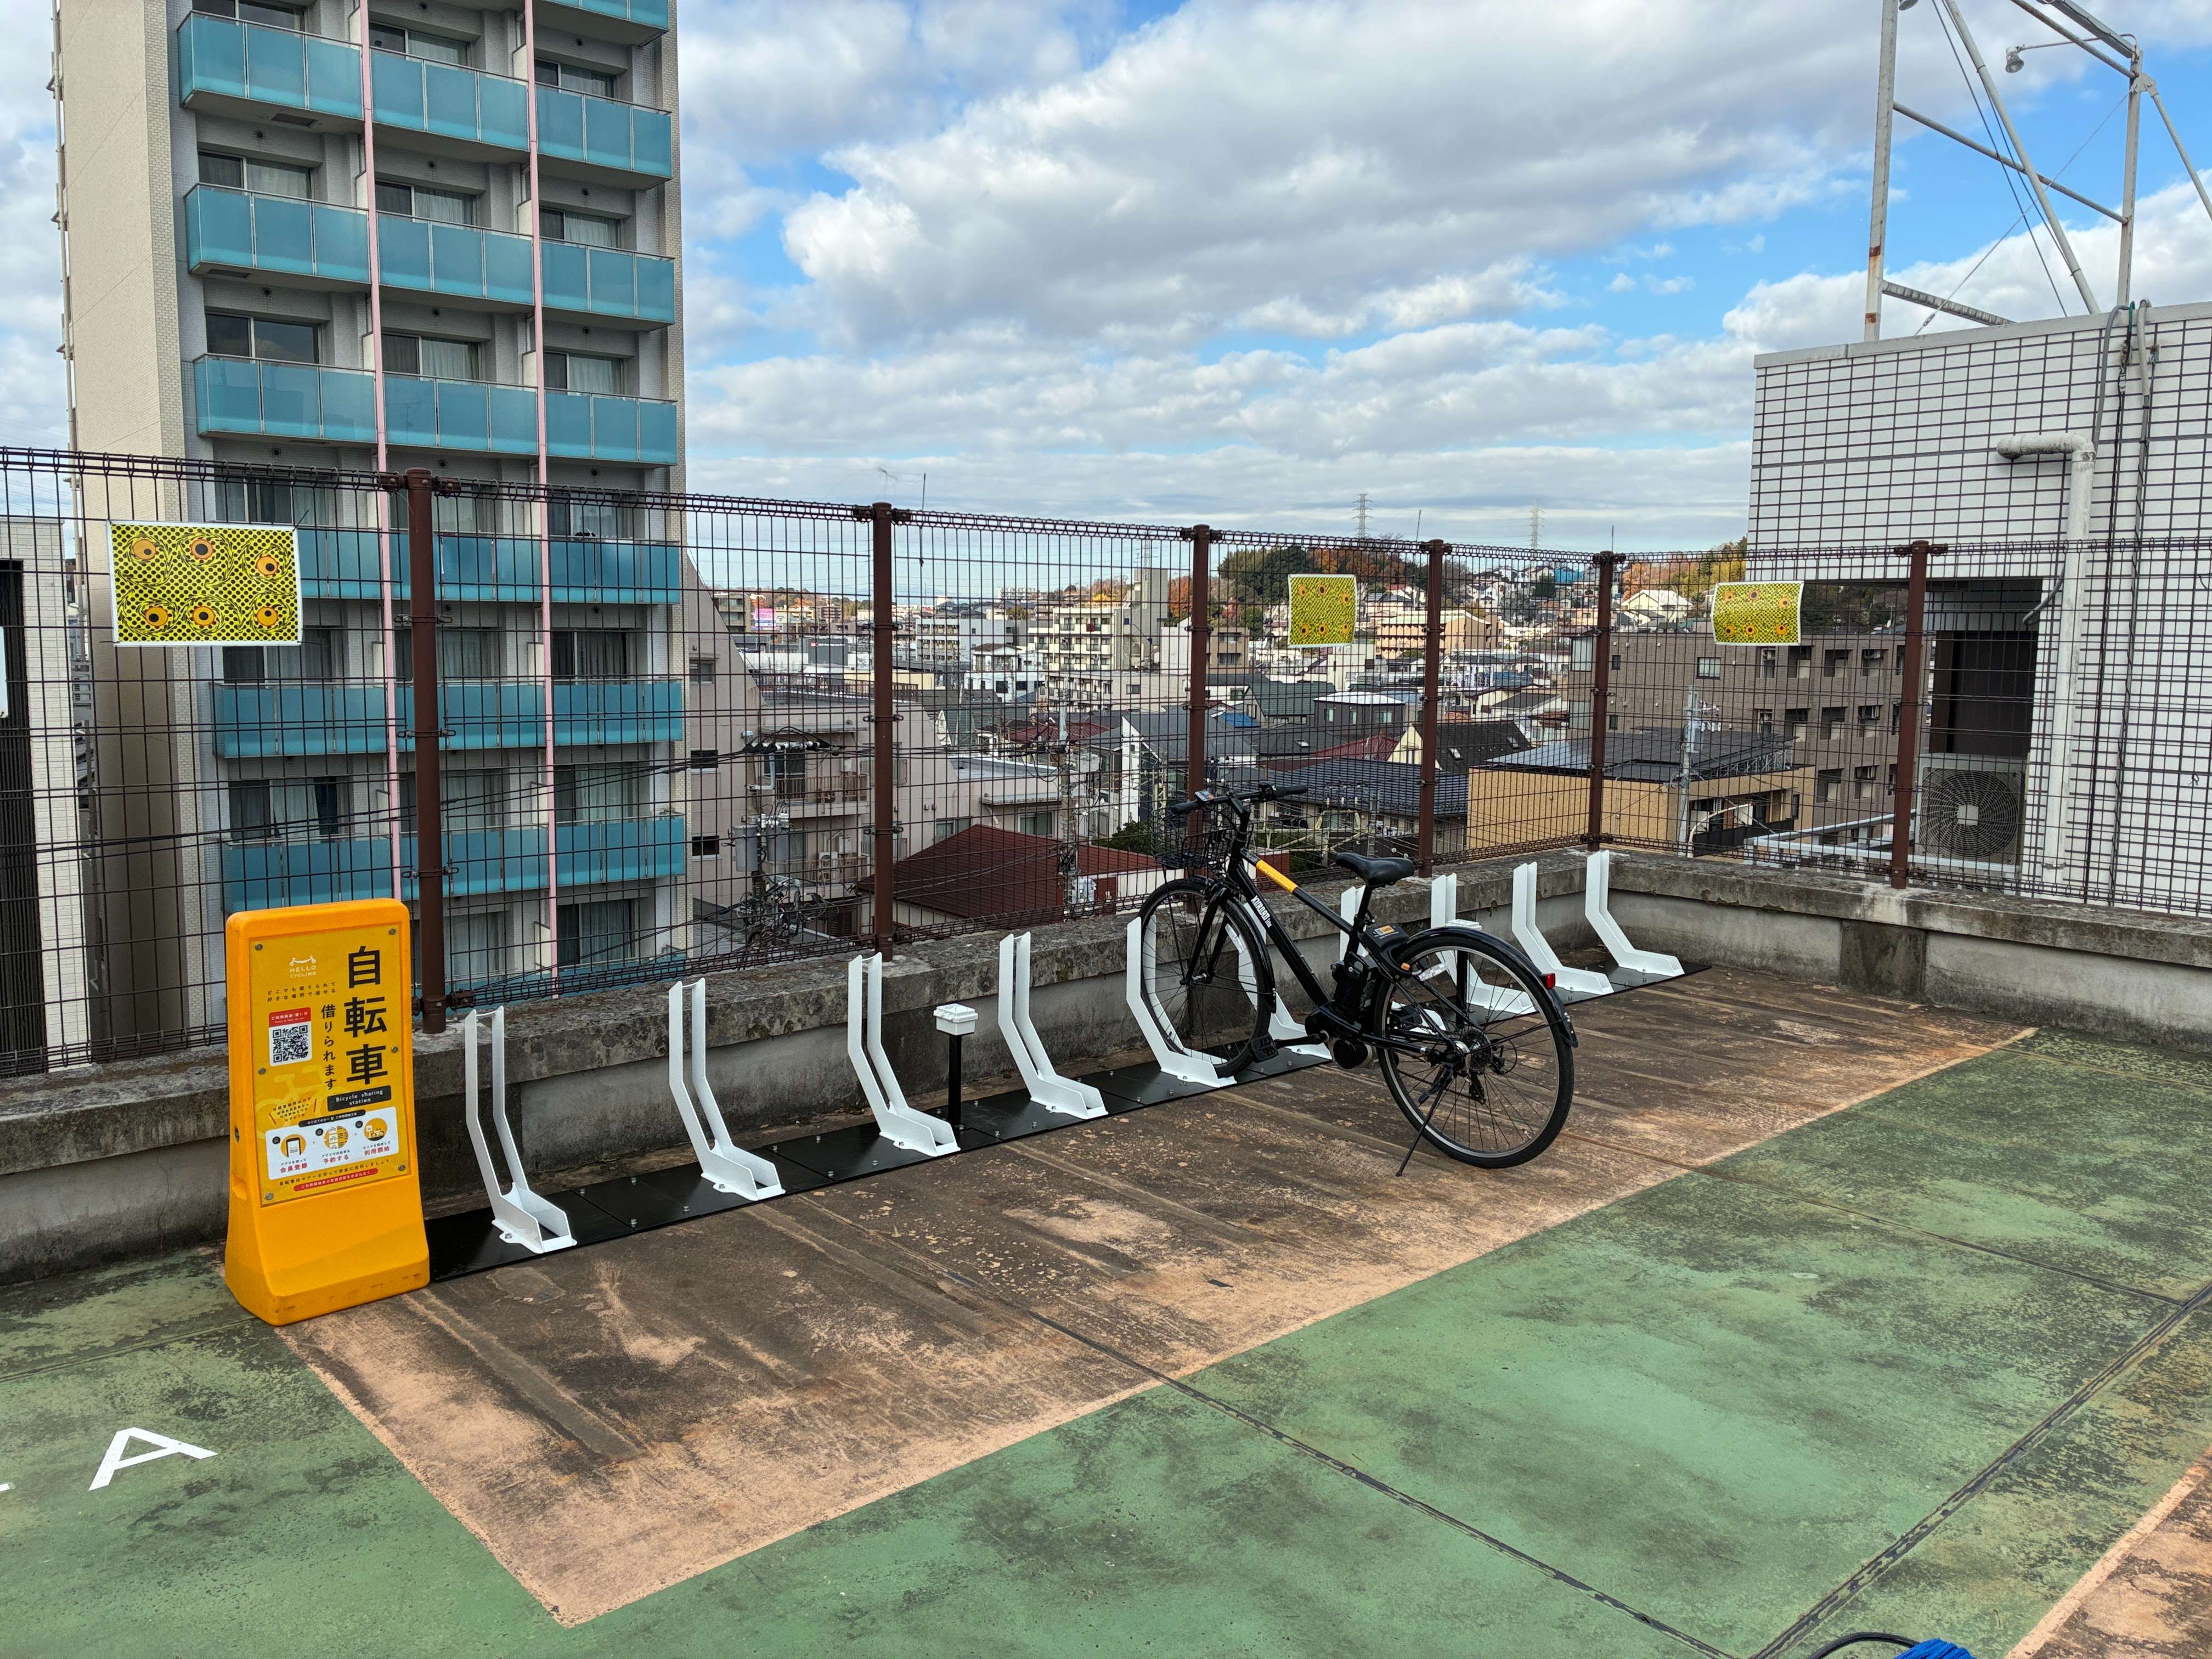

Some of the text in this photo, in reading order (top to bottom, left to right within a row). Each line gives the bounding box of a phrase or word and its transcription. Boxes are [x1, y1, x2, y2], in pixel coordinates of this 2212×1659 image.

[290, 965, 316, 973] HELLO
[343, 946, 388, 1085] 自転車
[320, 1004, 336, 1090] 借りられます
[335, 1094, 358, 1102] Bicycle
[364, 1146, 390, 1156] 利用開始
[323, 1154, 349, 1164] 予約する
[280, 1163, 307, 1173] 会員登録
